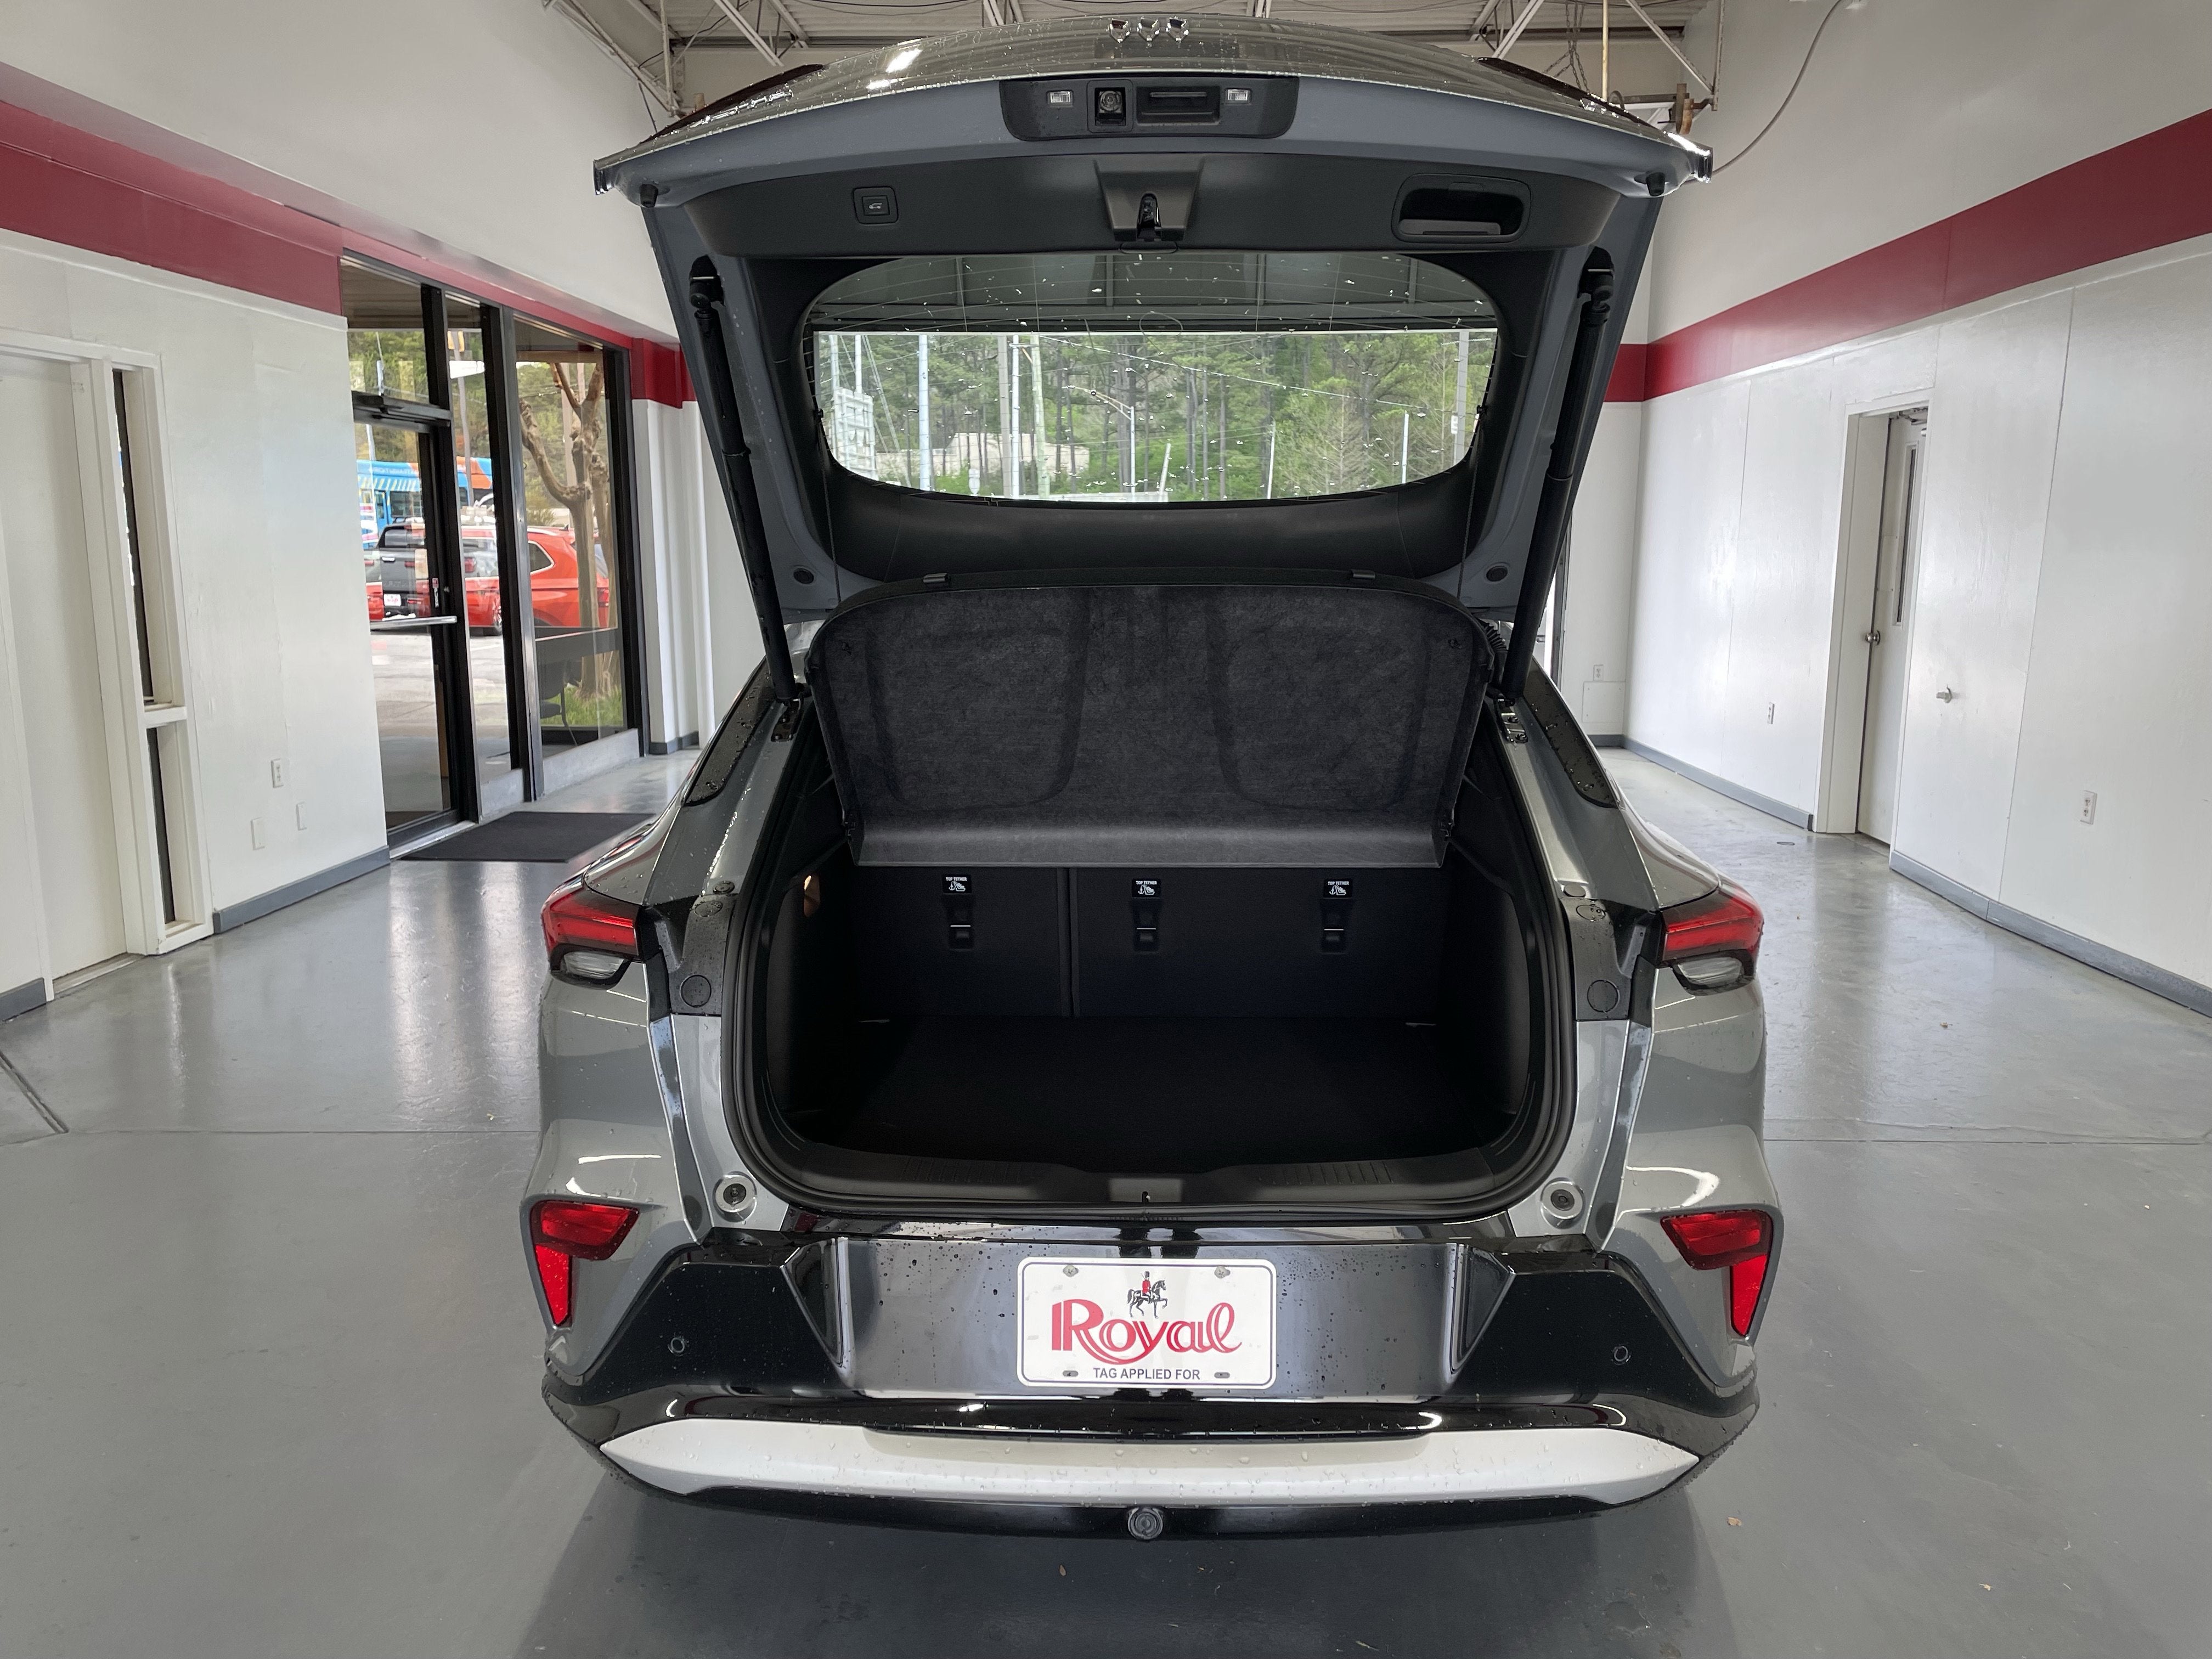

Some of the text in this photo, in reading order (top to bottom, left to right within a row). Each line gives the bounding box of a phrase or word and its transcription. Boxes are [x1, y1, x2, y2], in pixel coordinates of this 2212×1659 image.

[1052, 1299, 1242, 1365] Royal
[1093, 1368, 1200, 1380] TAG APPLIED FOR
